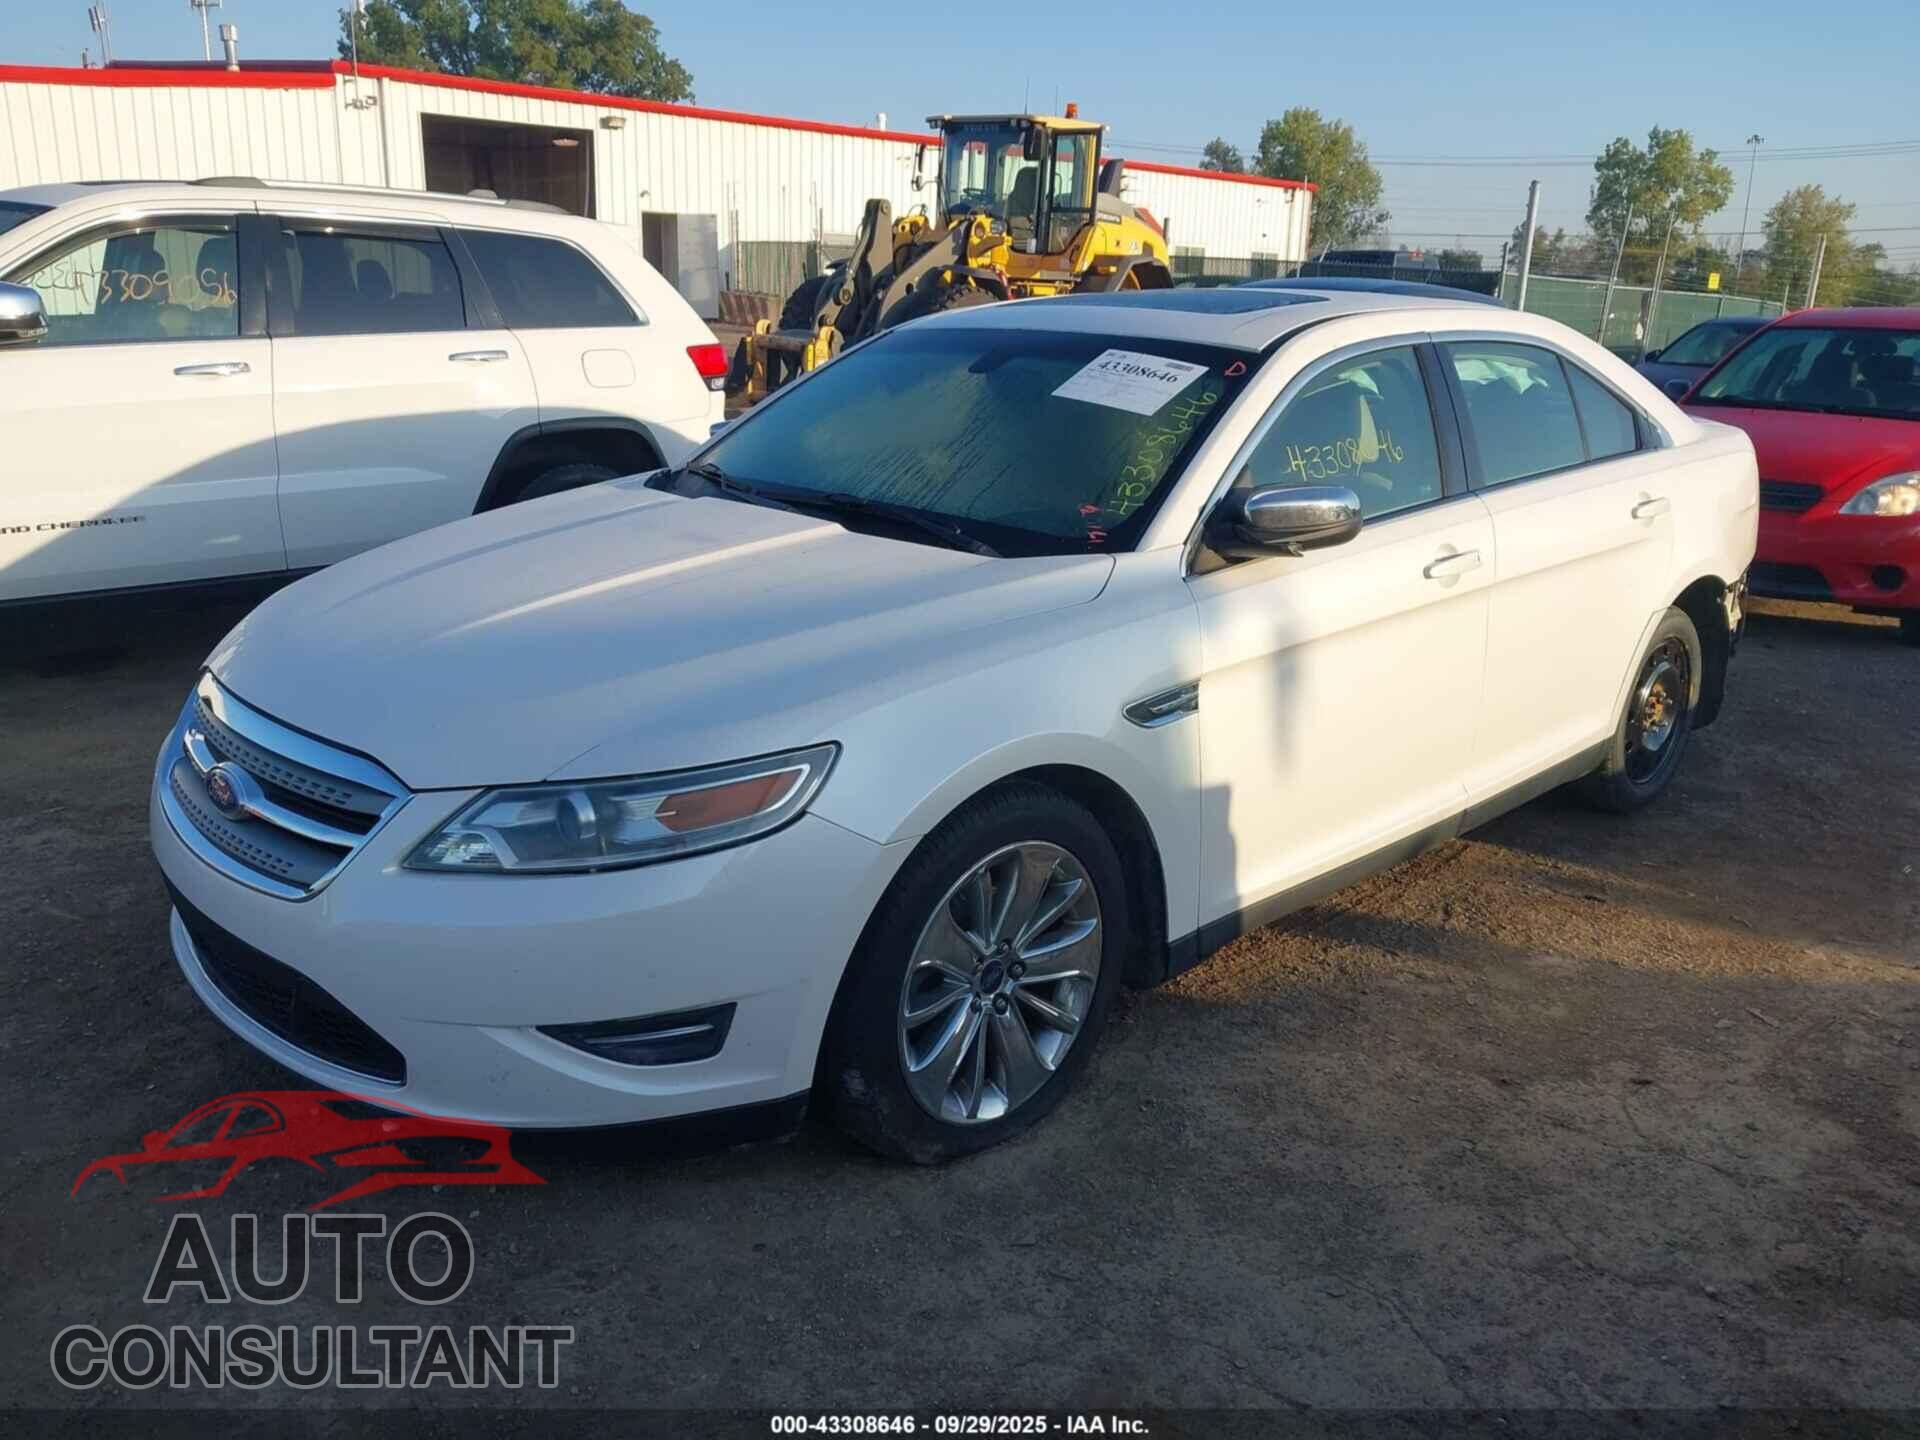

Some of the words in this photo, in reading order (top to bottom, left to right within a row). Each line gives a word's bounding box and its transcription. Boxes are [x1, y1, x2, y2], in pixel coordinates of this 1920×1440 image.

[1098, 360, 1179, 383] 43308646
[1107, 392, 1218, 515] 43308646
[0, 526, 31, 535] ND
